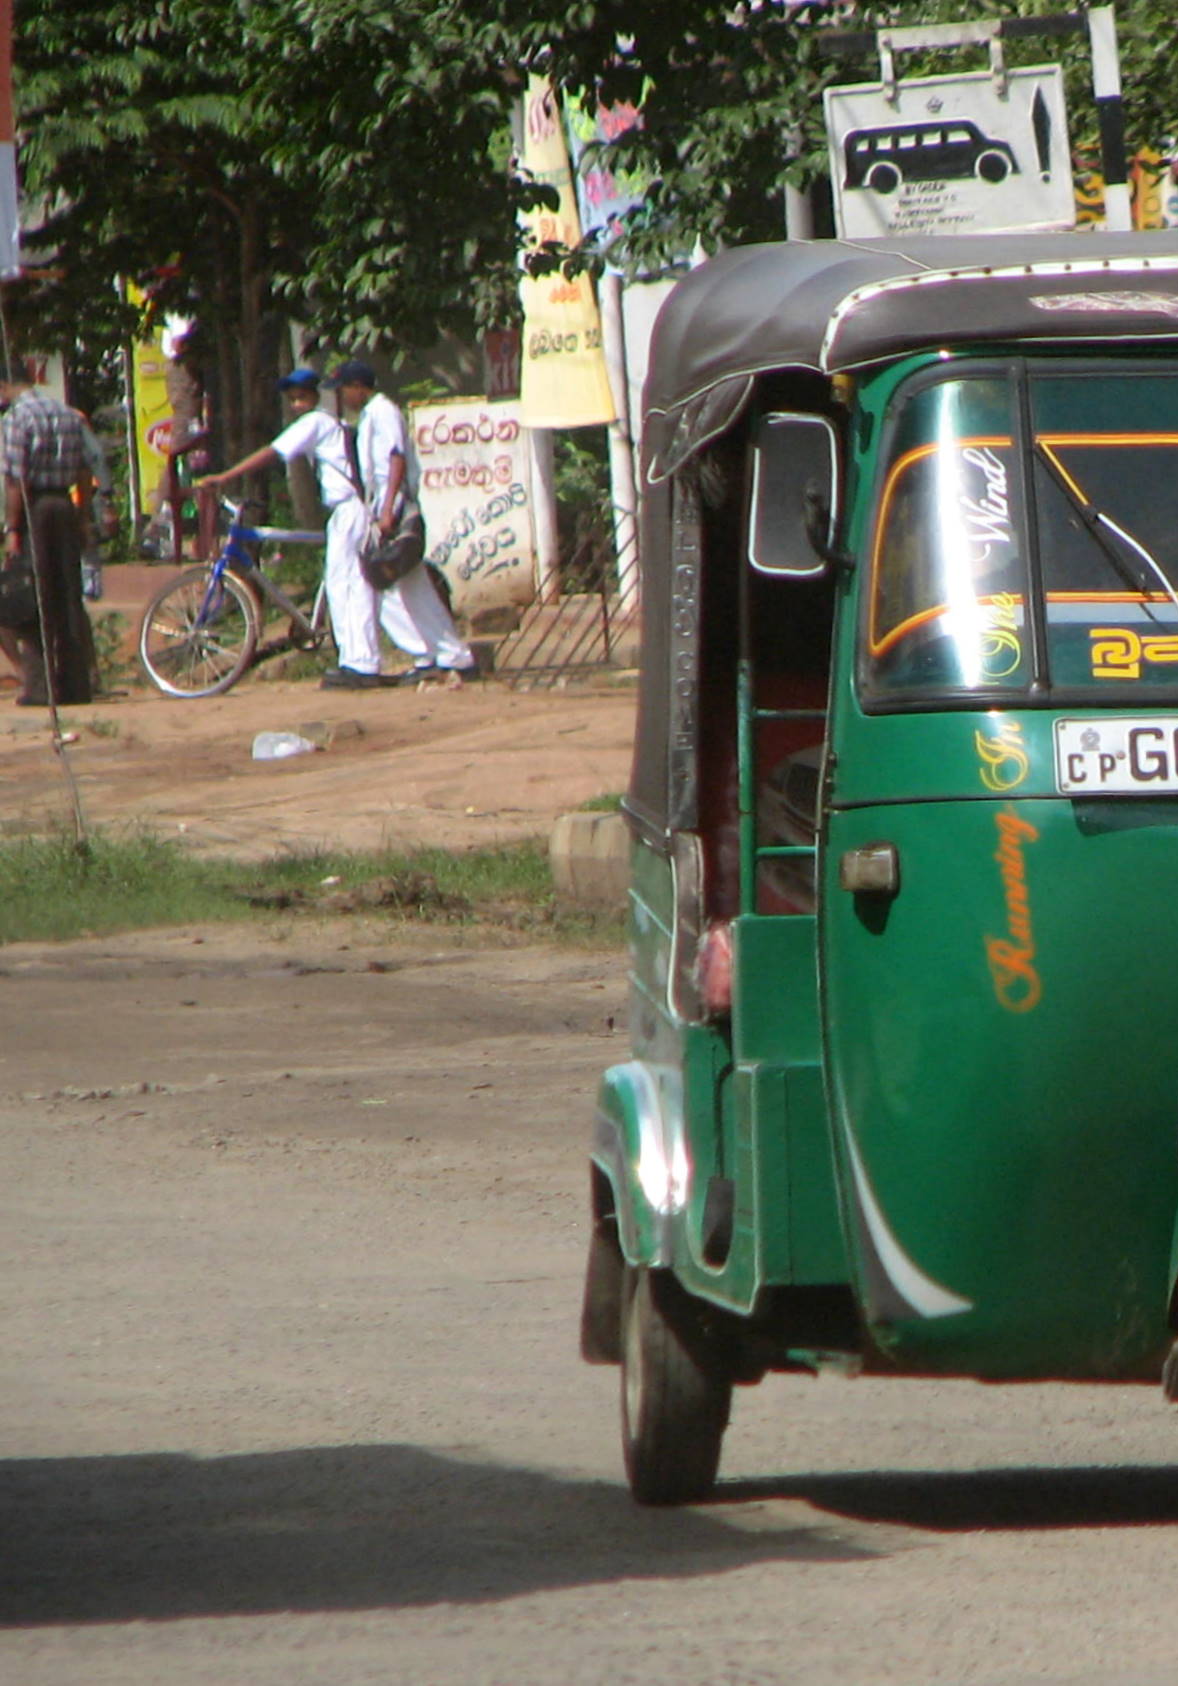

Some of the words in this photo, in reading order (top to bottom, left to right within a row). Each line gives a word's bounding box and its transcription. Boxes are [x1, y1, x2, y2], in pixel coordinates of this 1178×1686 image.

[961, 447, 1011, 562] Wind
[975, 721, 1029, 791] In
[986, 803, 1041, 1013] Running
